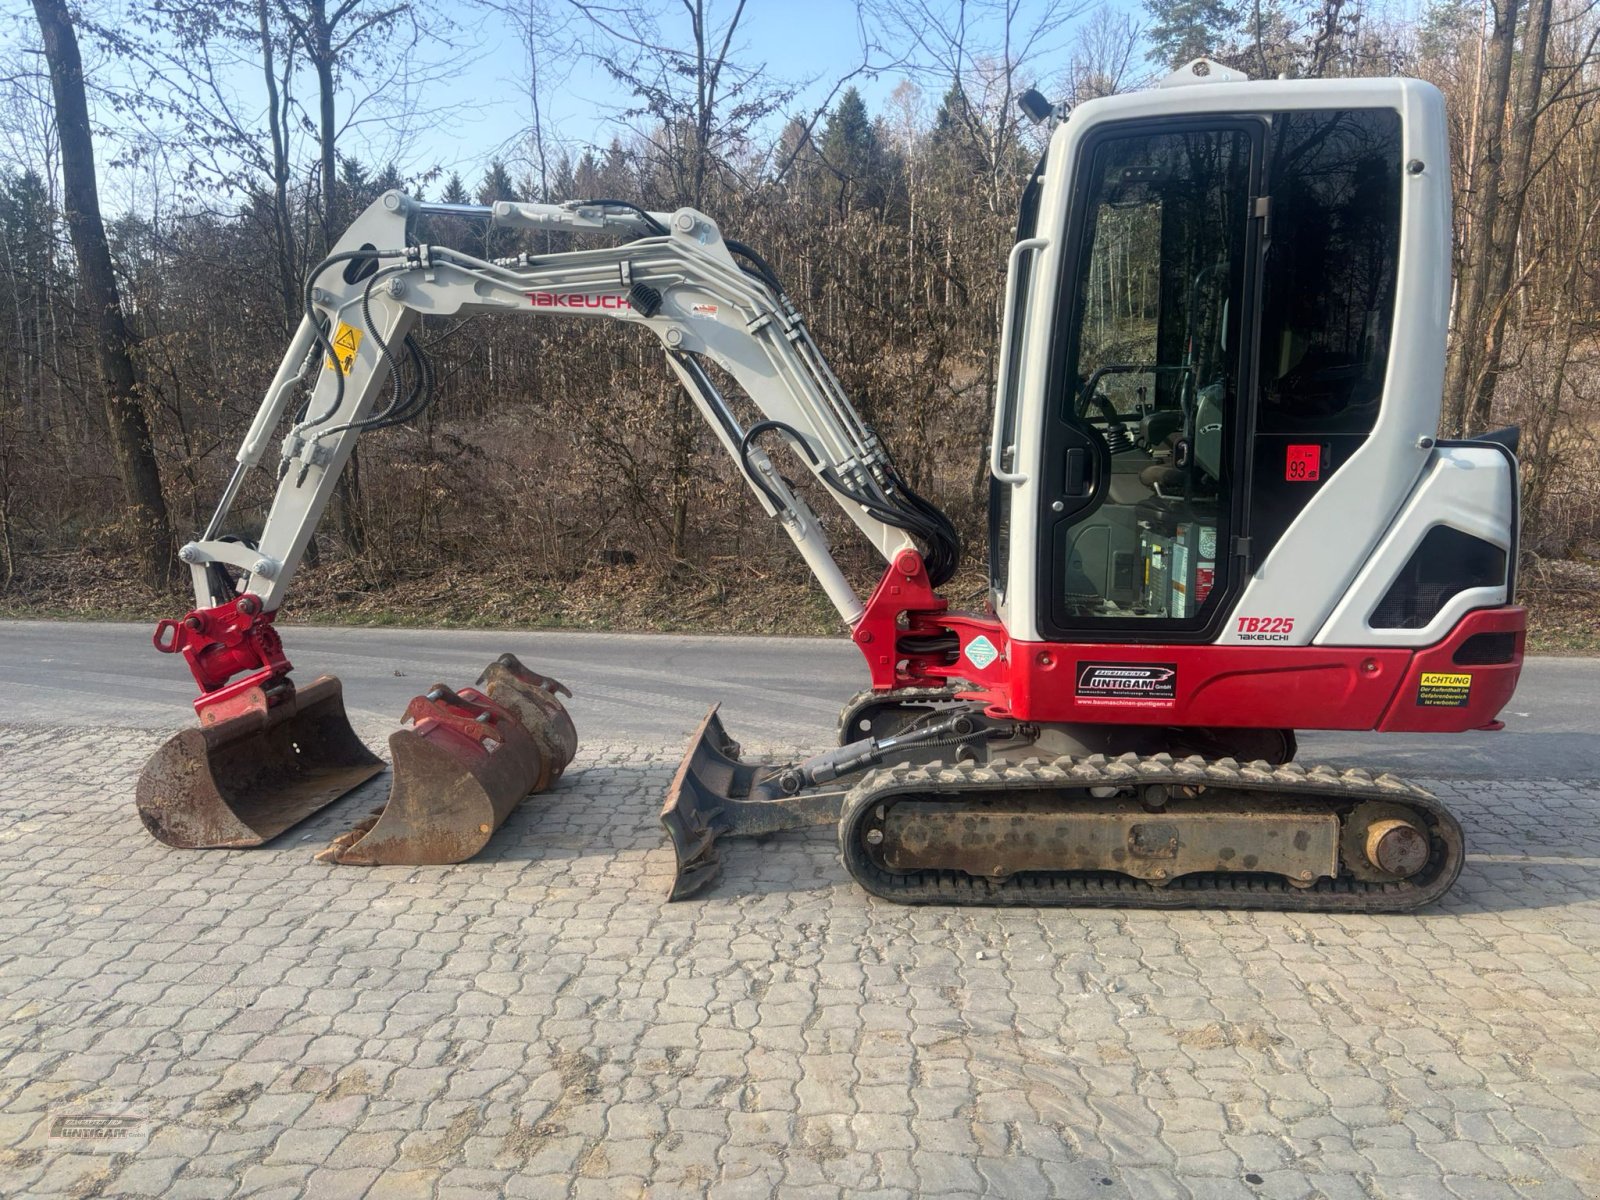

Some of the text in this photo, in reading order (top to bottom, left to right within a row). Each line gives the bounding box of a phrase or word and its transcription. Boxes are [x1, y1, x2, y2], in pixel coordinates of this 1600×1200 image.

[1290, 461, 1306, 478] 93
[1237, 617, 1295, 633] TB225
[1423, 676, 1469, 684] ACHTUNG
